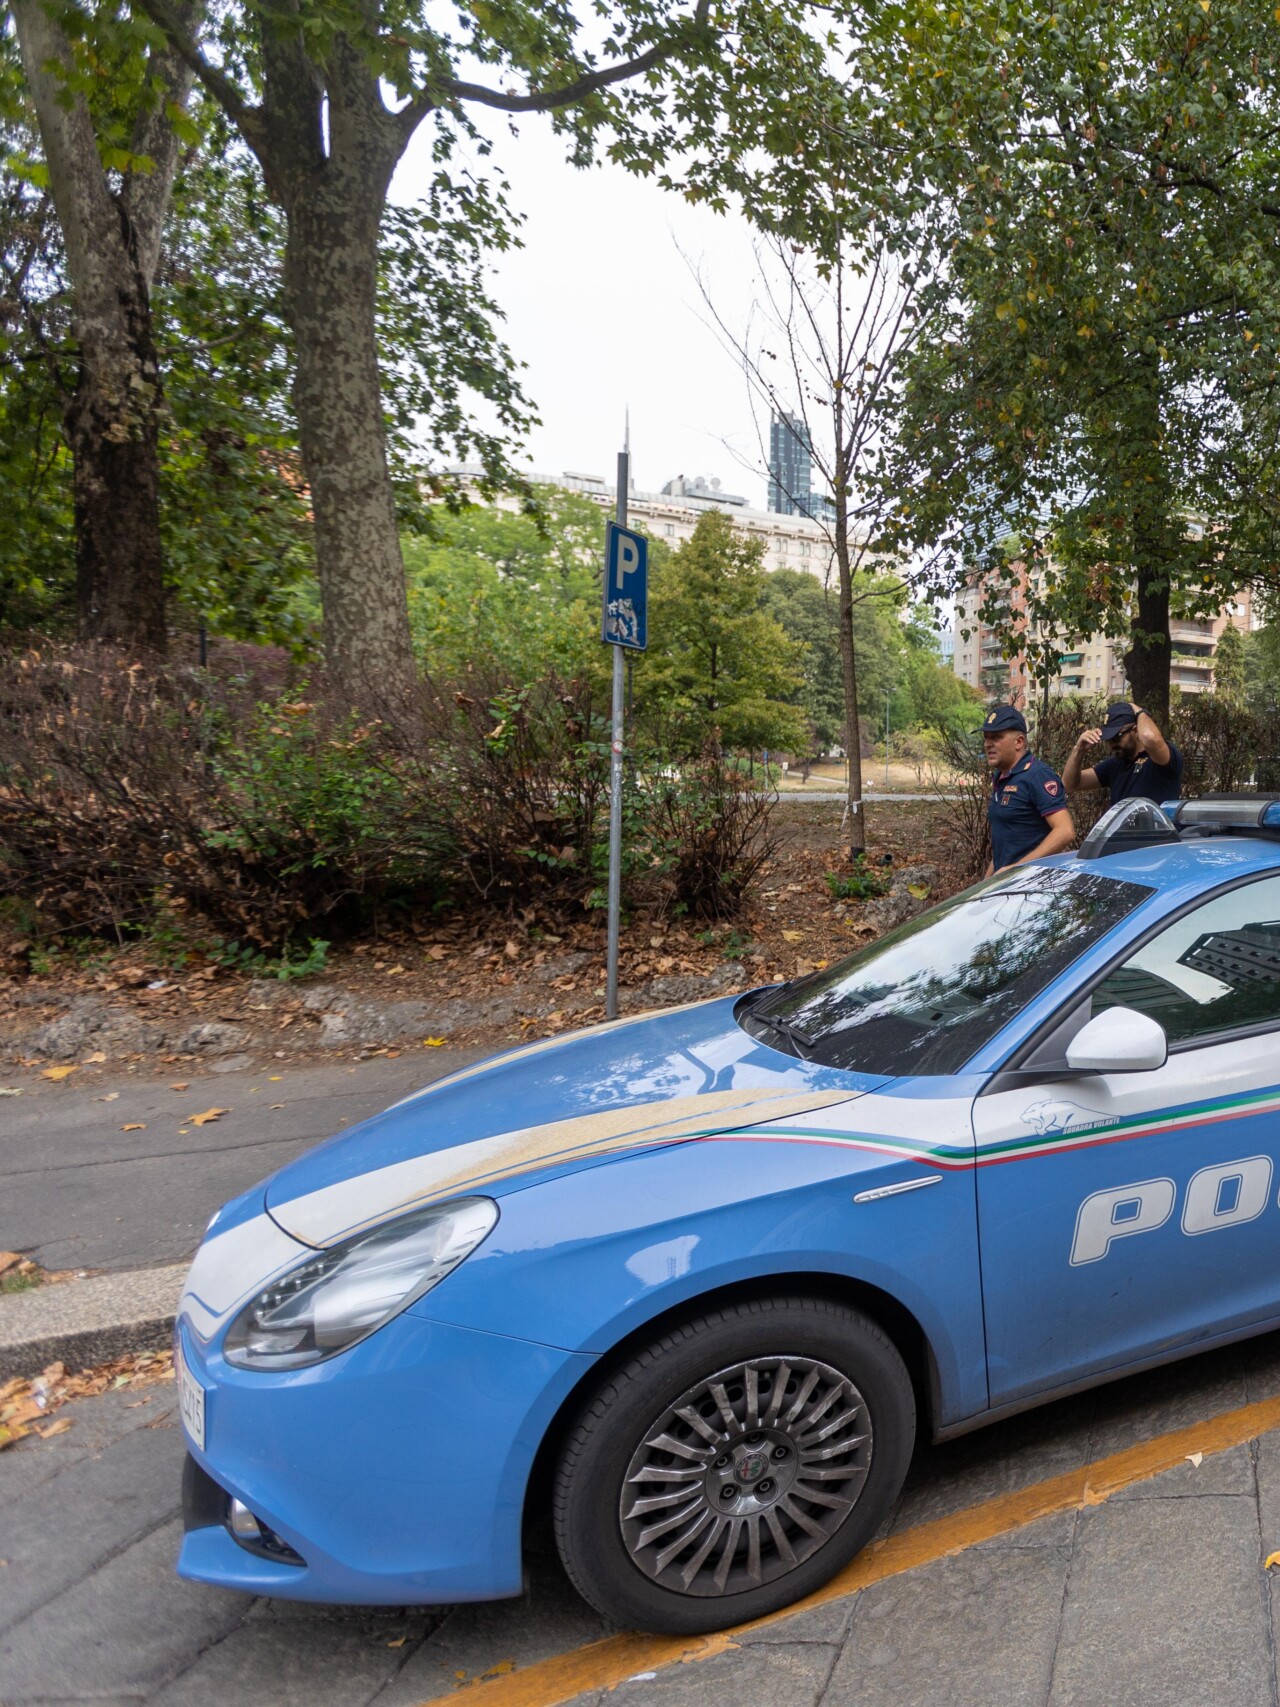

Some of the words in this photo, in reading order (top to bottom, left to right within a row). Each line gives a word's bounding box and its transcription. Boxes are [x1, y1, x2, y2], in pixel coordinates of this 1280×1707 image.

[616, 533, 640, 590] P
[1062, 1121, 1093, 1135] SQUADRA
[1093, 1116, 1120, 1129] VOLANTE
